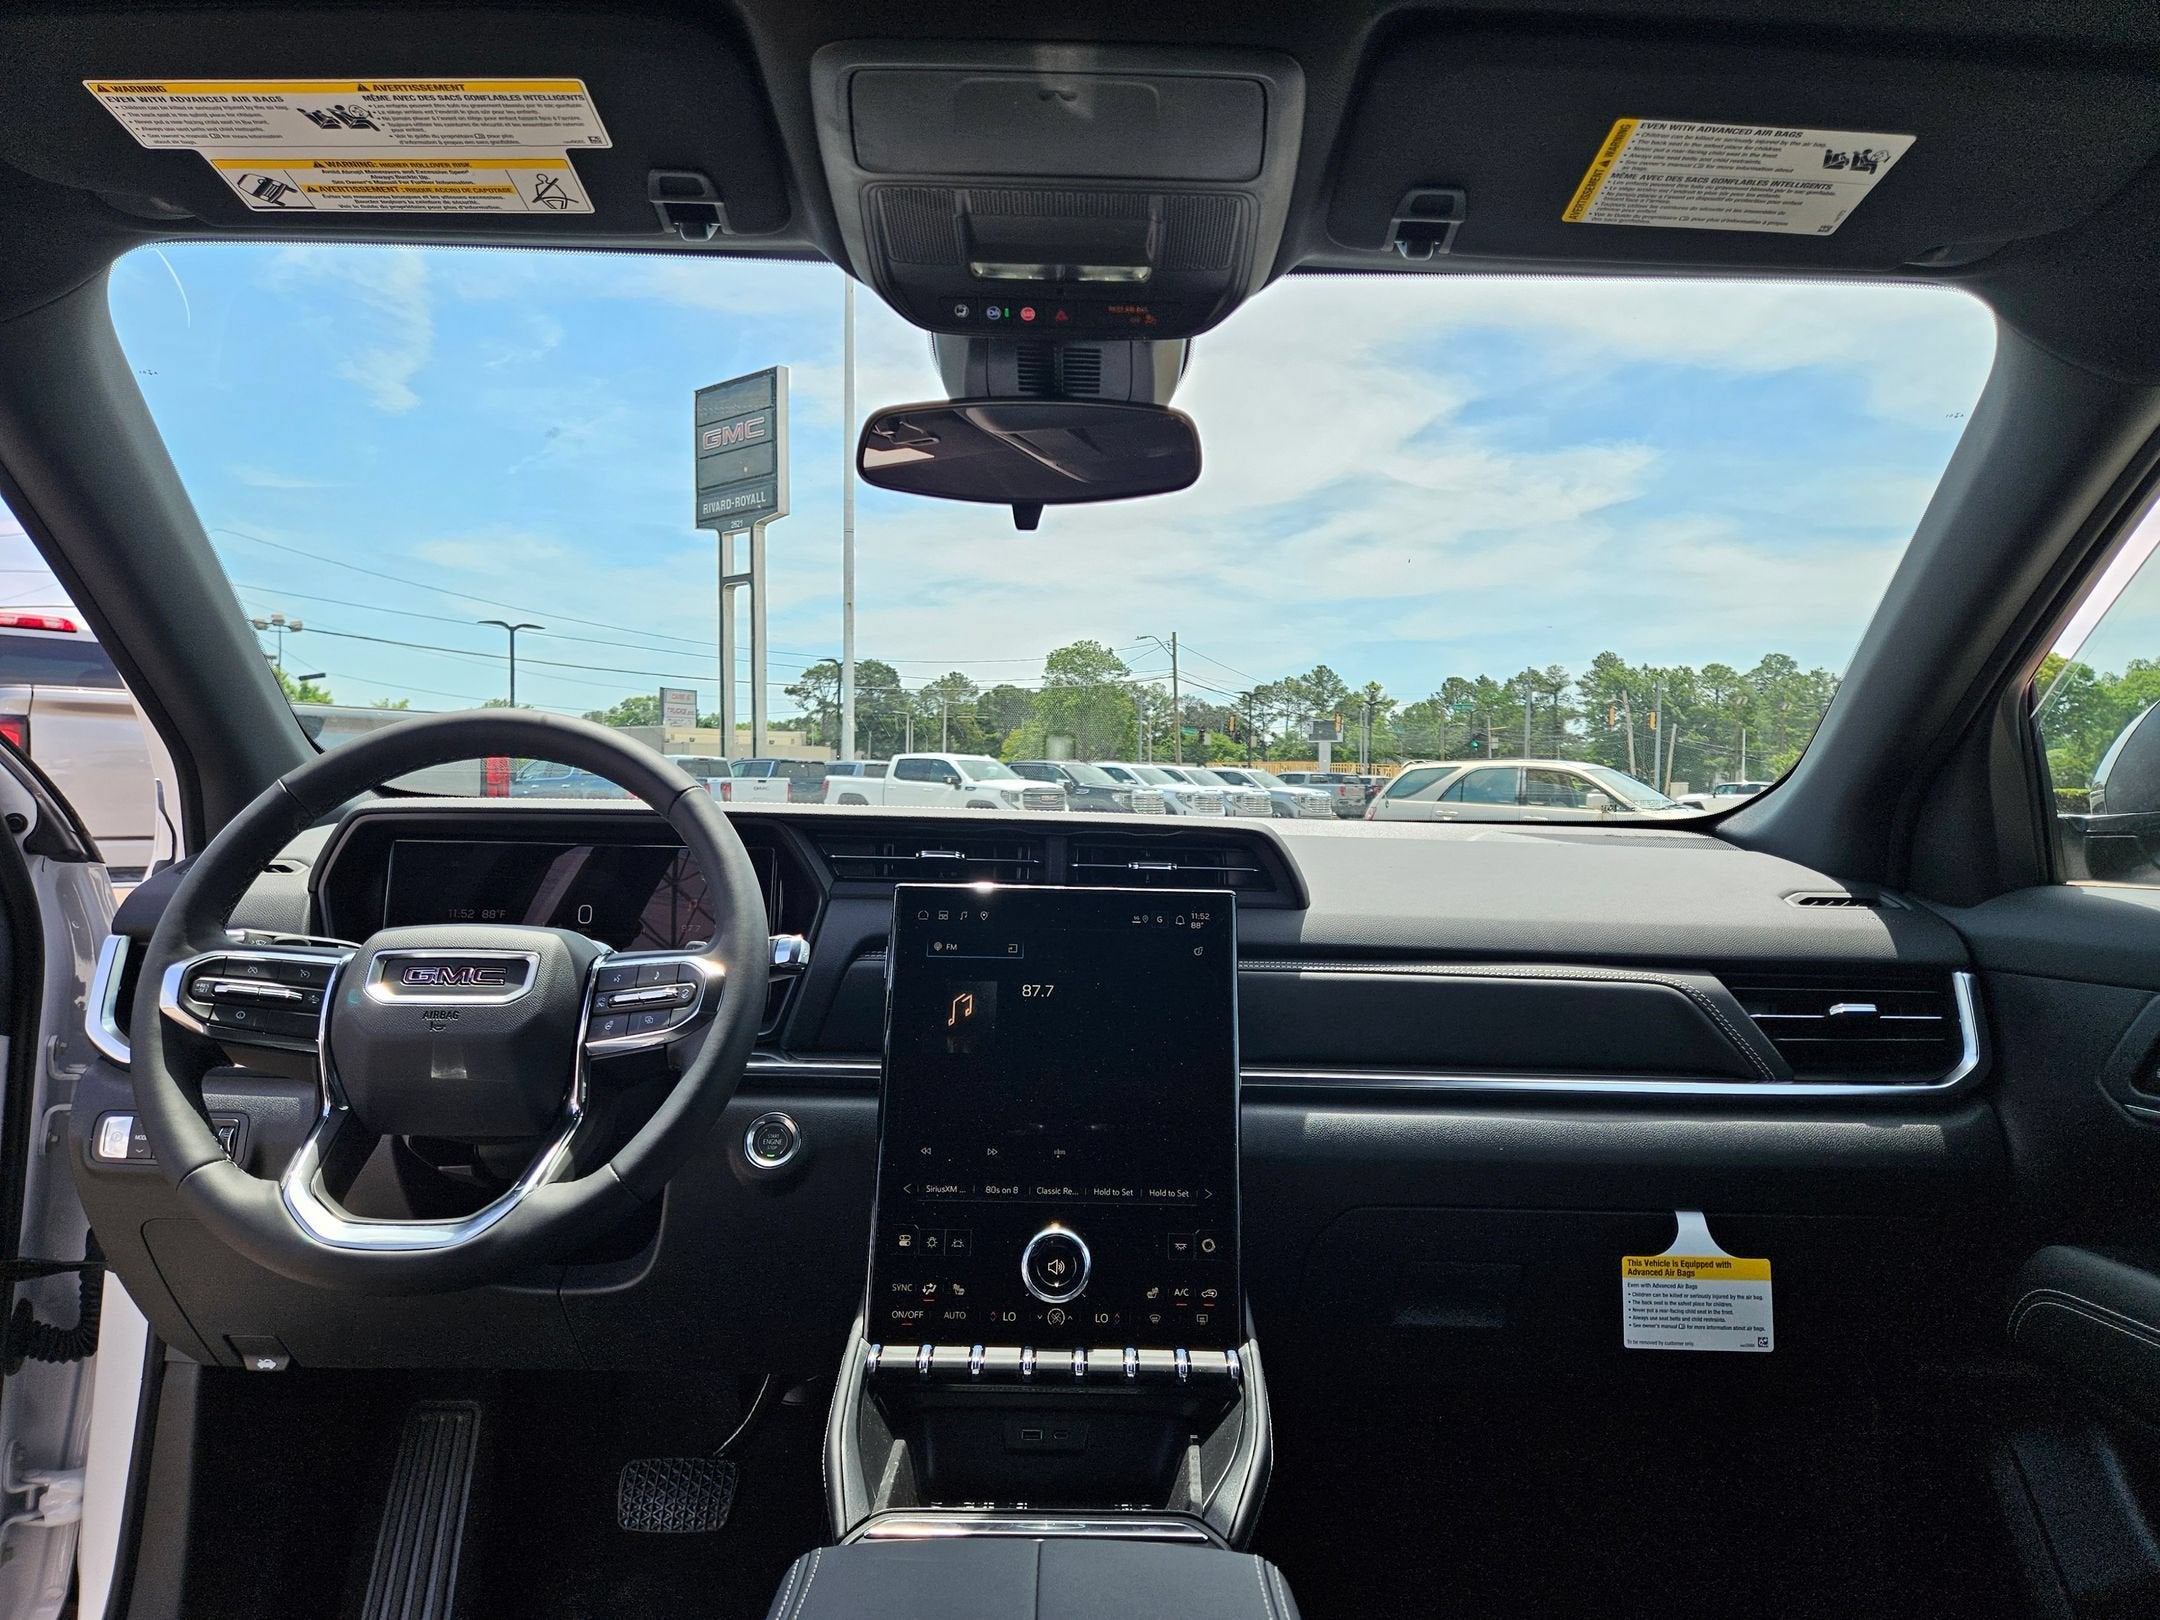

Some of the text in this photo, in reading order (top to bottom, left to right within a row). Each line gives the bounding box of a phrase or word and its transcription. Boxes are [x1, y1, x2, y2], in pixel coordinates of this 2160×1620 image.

[373, 84, 465, 92] AVERTISSEMENT
[362, 94, 391, 102] MÊME
[1640, 122, 1804, 139] EVEN WITH ADVANCED AIR BAGS
[703, 416, 765, 450] GMC
[703, 491, 767, 515] RIVARD-ROYALL
[448, 908, 475, 919] 11:52
[578, 904, 593, 924] 0
[1190, 912, 1210, 920] 11:52
[1190, 921, 1204, 929] 88°
[946, 943, 958, 951] FM
[403, 966, 506, 986] GMC
[1022, 984, 1055, 998] 87.7
[422, 1010, 460, 1020] AIRBAG
[926, 1184, 958, 1194] SiriusXM
[985, 1185, 1000, 1194] 80s
[1012, 1186, 1019, 1195] 8
[1036, 1186, 1061, 1196] Classic
[1093, 1187, 1111, 1196] Hold
[1121, 1188, 1134, 1197] Set
[1149, 1188, 1190, 1198] Hold to Set
[1628, 1259, 1643, 1267] This
[1644, 1259, 1671, 1267] Vehicle
[1680, 1260, 1714, 1270] Equipped
[1715, 1260, 1732, 1268] with
[1628, 1268, 1663, 1276] Advanced
[1677, 1269, 1695, 1278] Bags
[892, 1283, 913, 1293] SYNC
[1173, 1287, 1189, 1297] A/C
[891, 1310, 1109, 1323] ON/OFF AUTO LO LO
